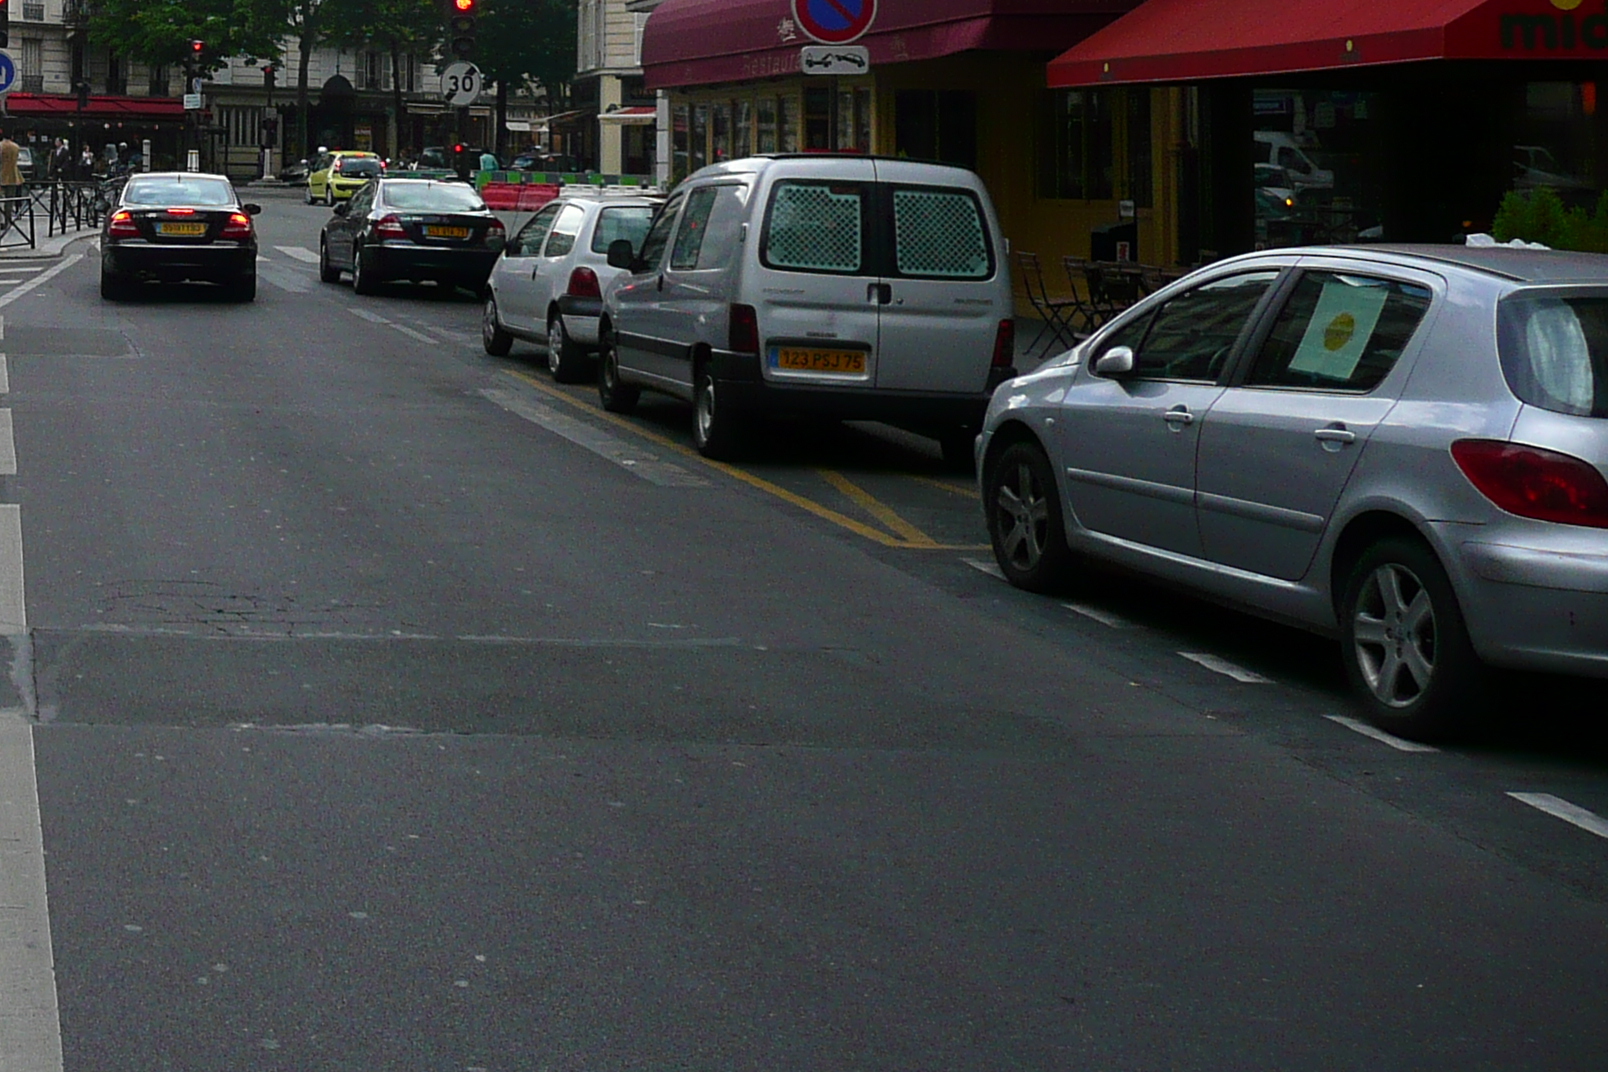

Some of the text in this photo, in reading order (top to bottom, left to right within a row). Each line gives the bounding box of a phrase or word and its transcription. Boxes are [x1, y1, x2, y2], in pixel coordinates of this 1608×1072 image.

[449, 75, 473, 92] 30
[783, 349, 863, 370] 123 PSJ 75
